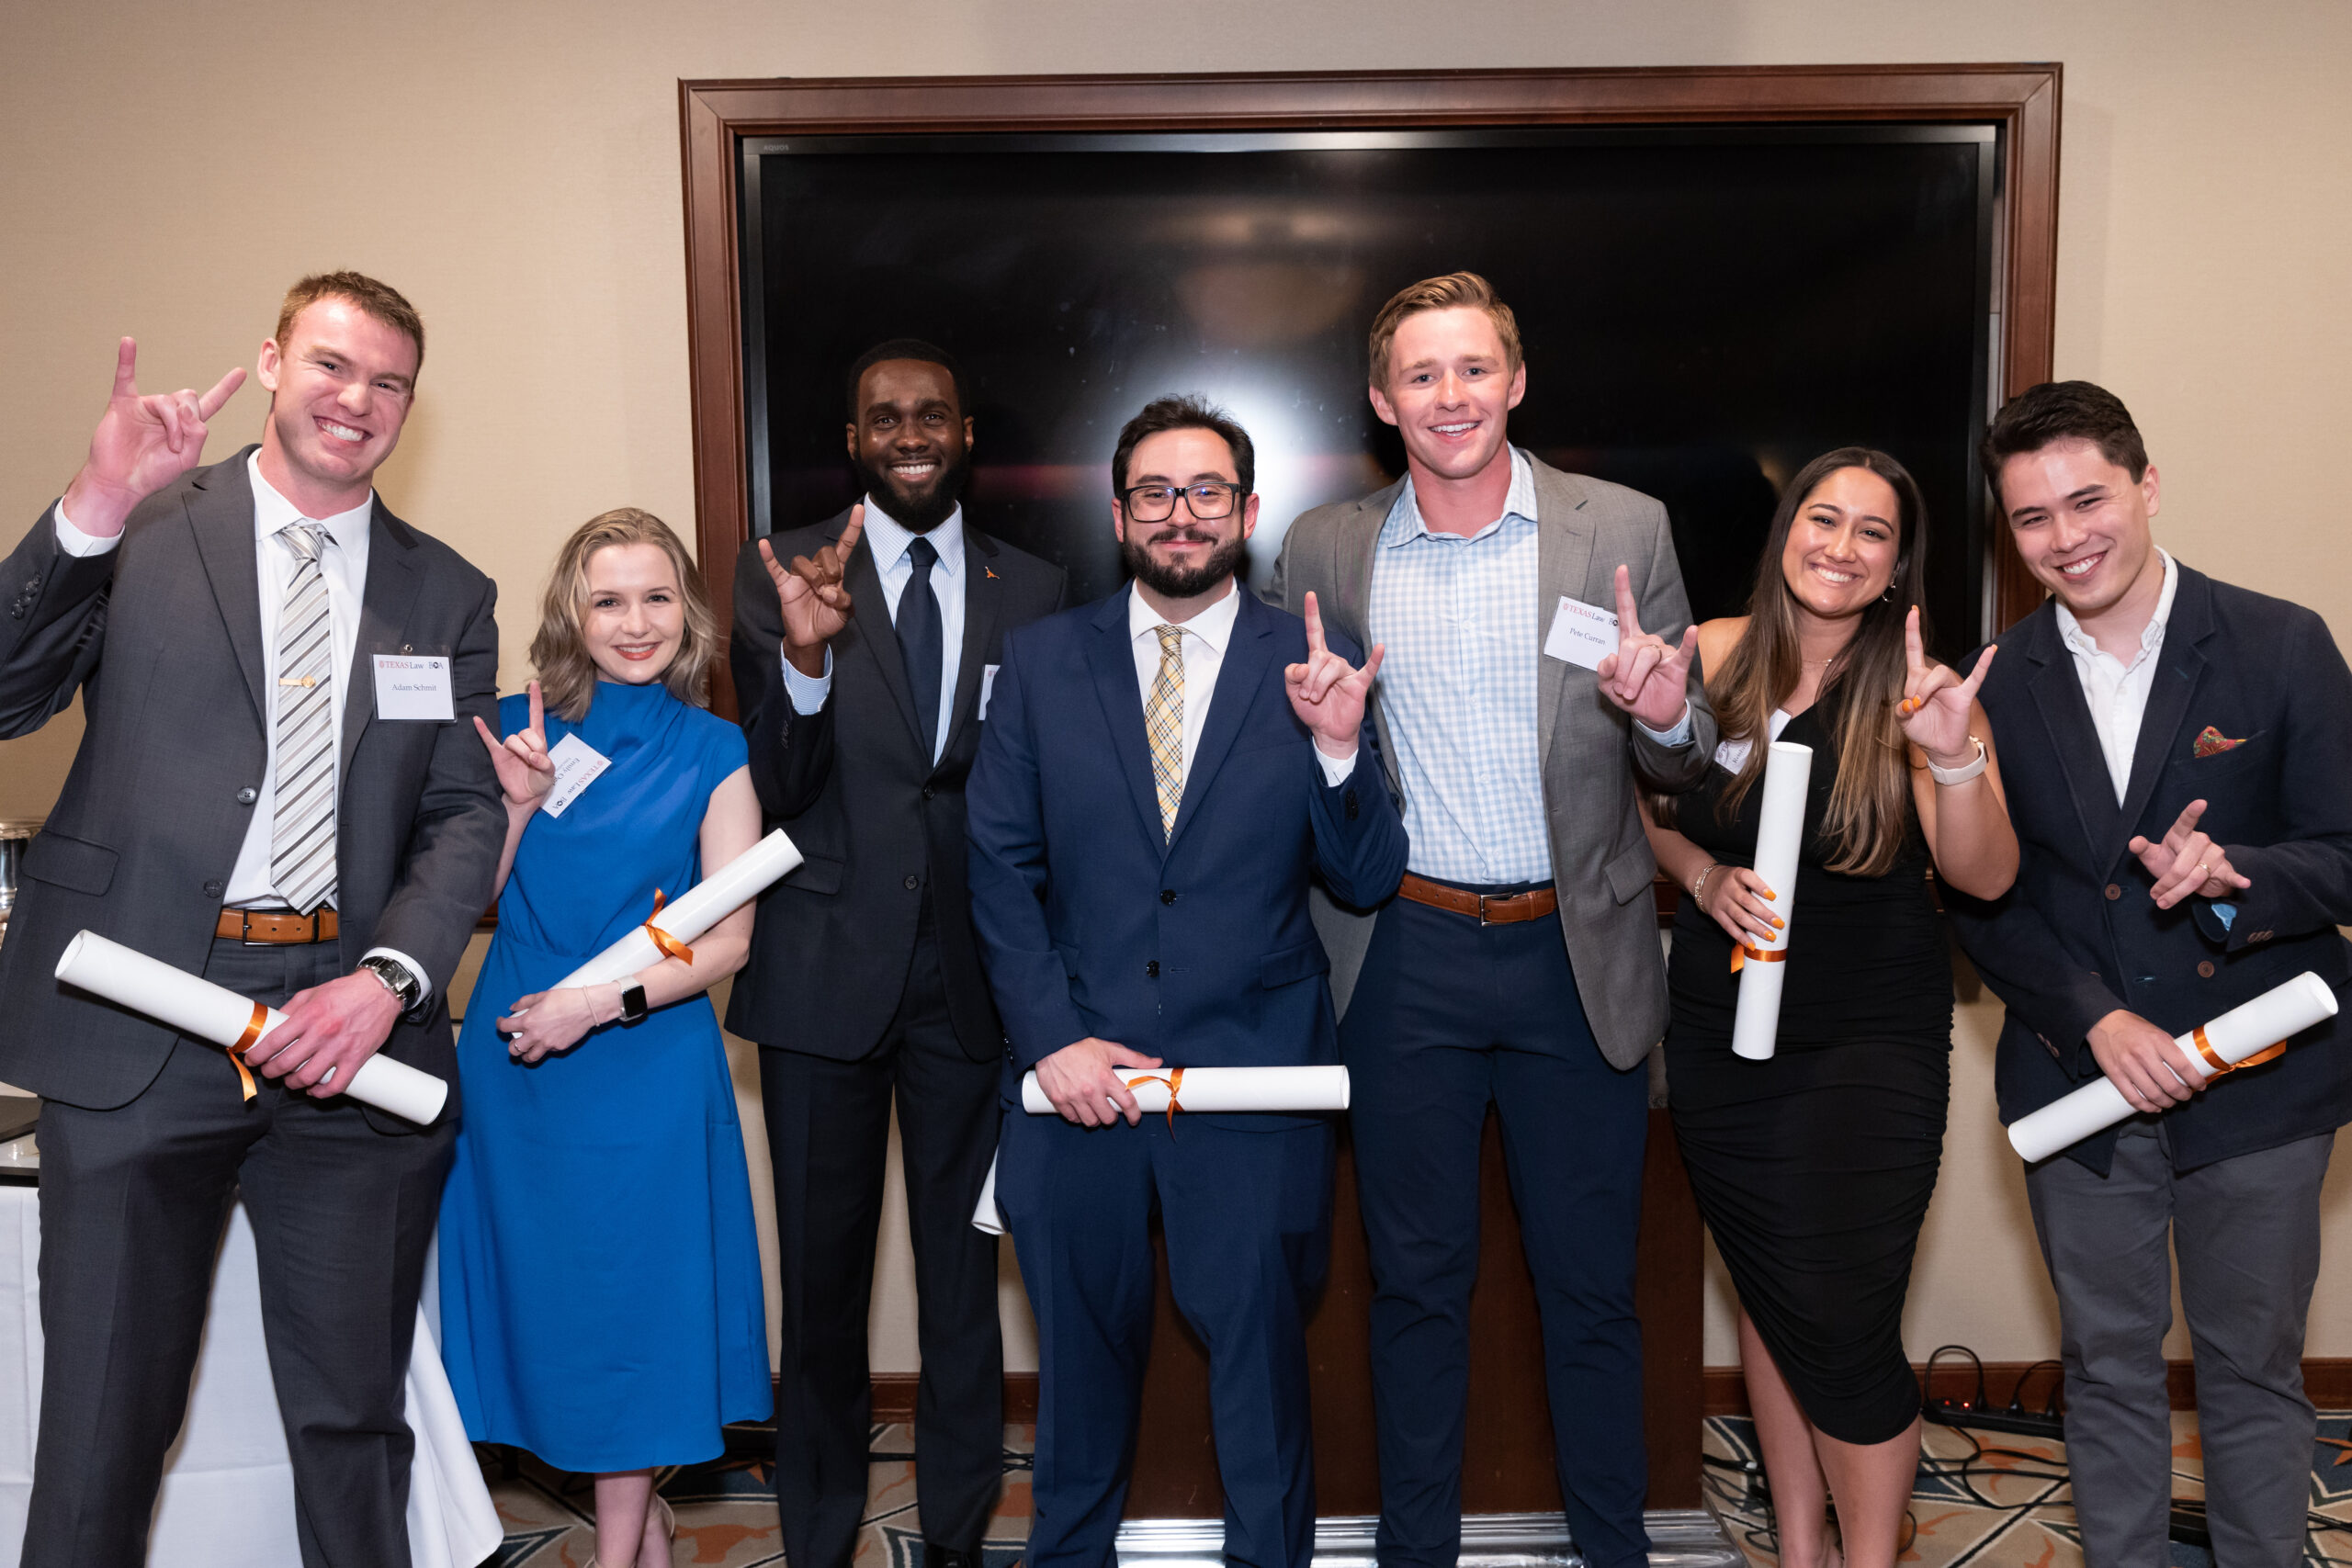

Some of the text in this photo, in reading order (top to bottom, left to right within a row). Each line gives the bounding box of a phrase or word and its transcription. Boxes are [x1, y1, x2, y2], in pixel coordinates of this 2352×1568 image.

[763, 143, 790, 152] AQUOS
[1569, 604, 1592, 618] TEXAS
[1591, 613, 1604, 623] Law
[1569, 627, 1606, 646] Pete Curran
[385, 660, 410, 670] TEXAS
[410, 661, 424, 670] Law
[391, 683, 437, 692] Adam Schmit
[563, 758, 581, 773] Emily
[578, 765, 599, 784] TEXAS
[567, 782, 581, 795] Law
